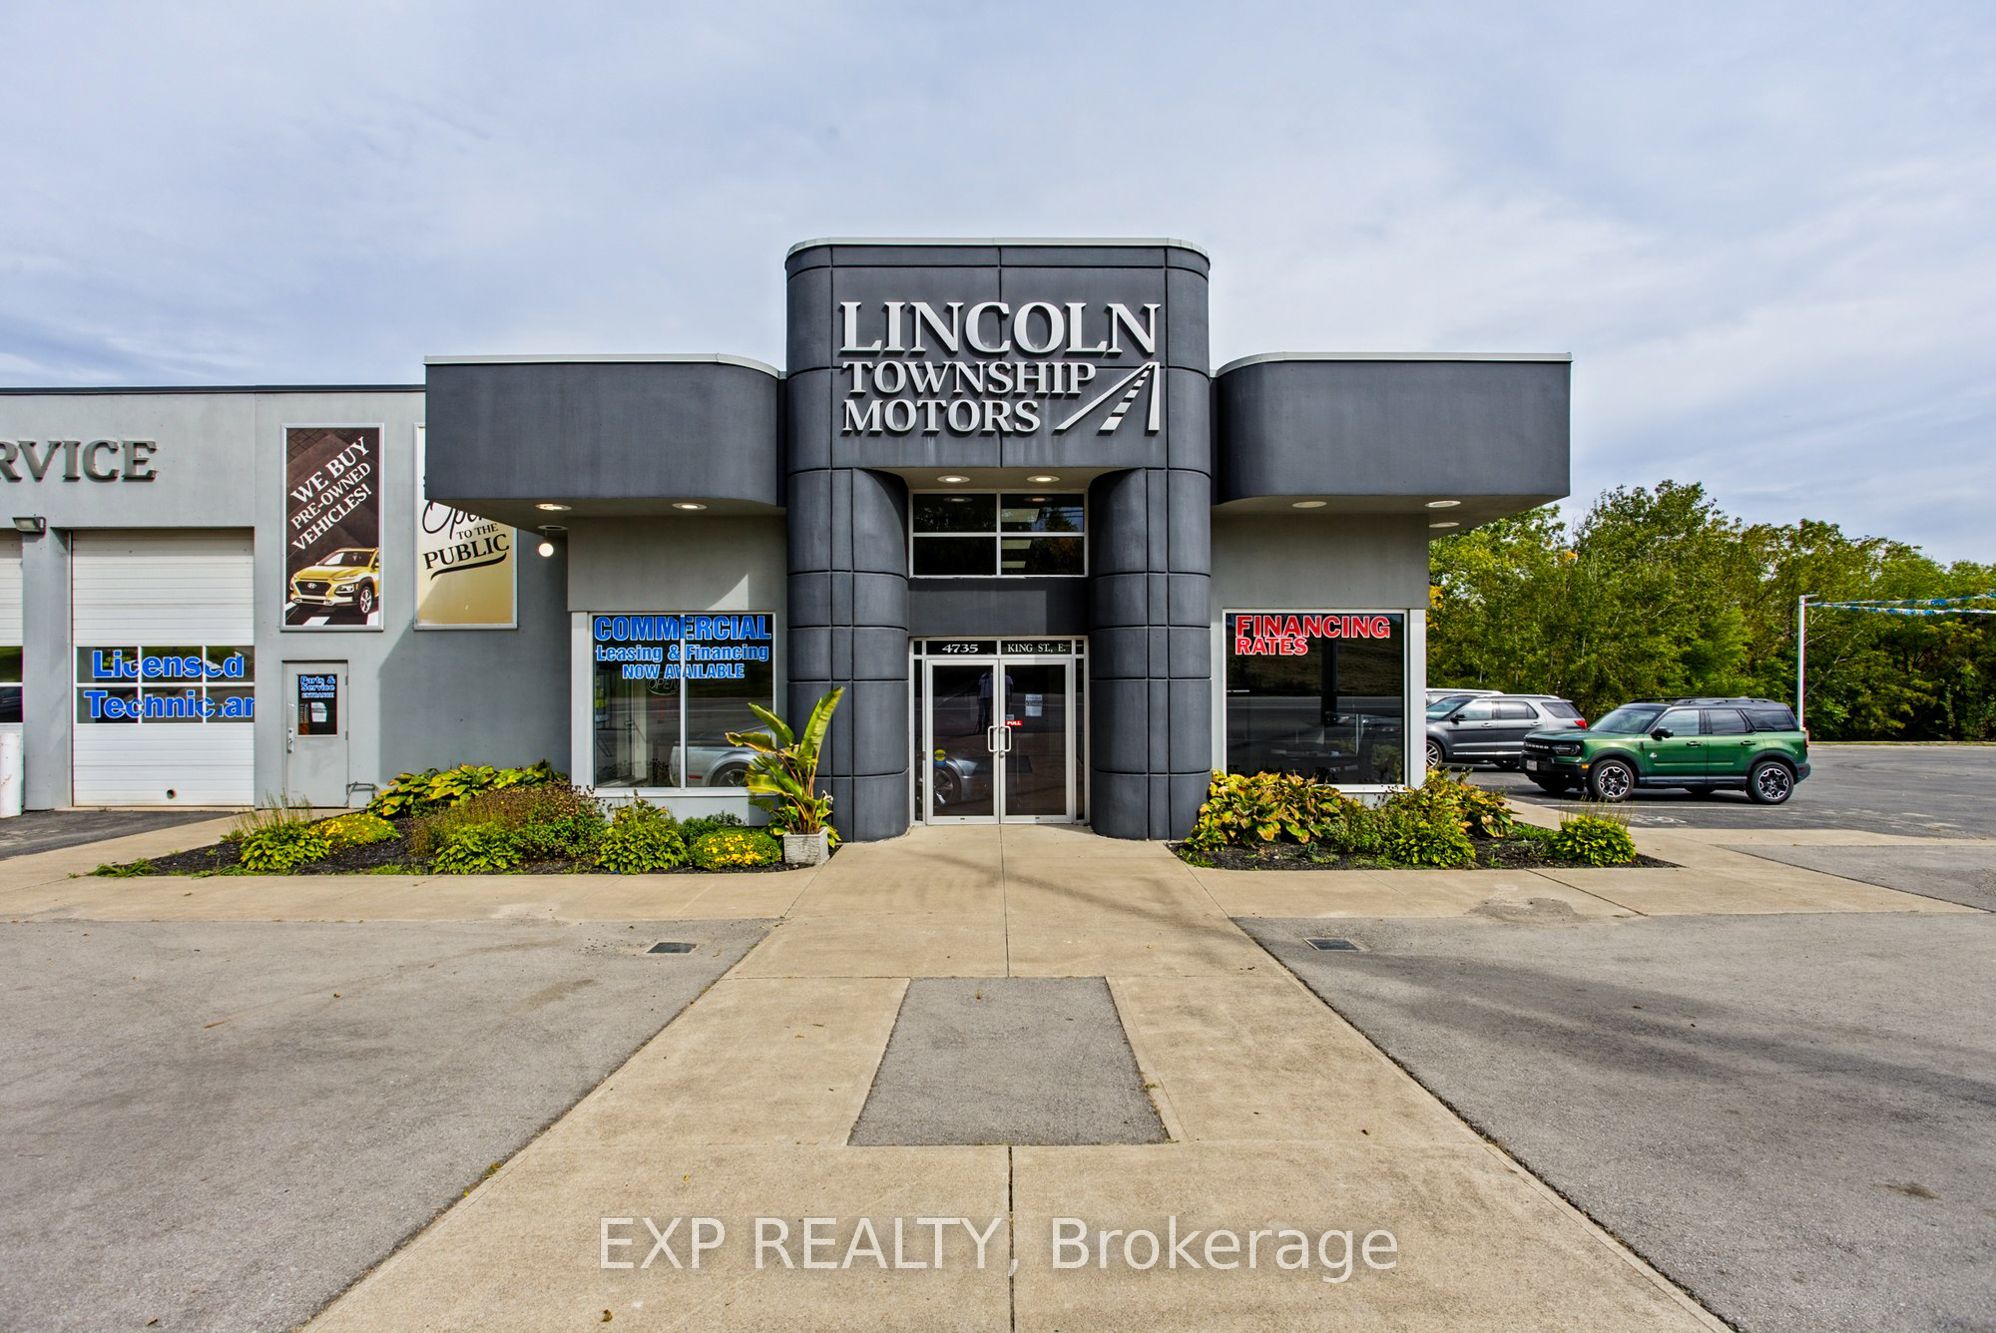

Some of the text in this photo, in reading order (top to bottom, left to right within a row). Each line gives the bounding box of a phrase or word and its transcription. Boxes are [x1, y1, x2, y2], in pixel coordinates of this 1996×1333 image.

[839, 301, 1161, 354] LINCOLN
[842, 361, 1096, 396] TOWNSHIP
[842, 399, 1041, 433] MOTORS
[290, 436, 370, 503] WE BUY
[290, 462, 371, 530] PRE-OWNED
[291, 483, 372, 550] VEHICLES!
[456, 523, 499, 540] TO THE
[423, 533, 510, 570] PUBLIC
[594, 616, 771, 641] COMMERCIAL
[1235, 615, 1391, 638] FINANCING
[596, 644, 769, 662] Leasing & Financing
[942, 643, 979, 654] 4735
[1007, 643, 1033, 653] KING
[1235, 637, 1309, 656] RATES
[622, 663, 745, 680] NOW AVAILABLE
